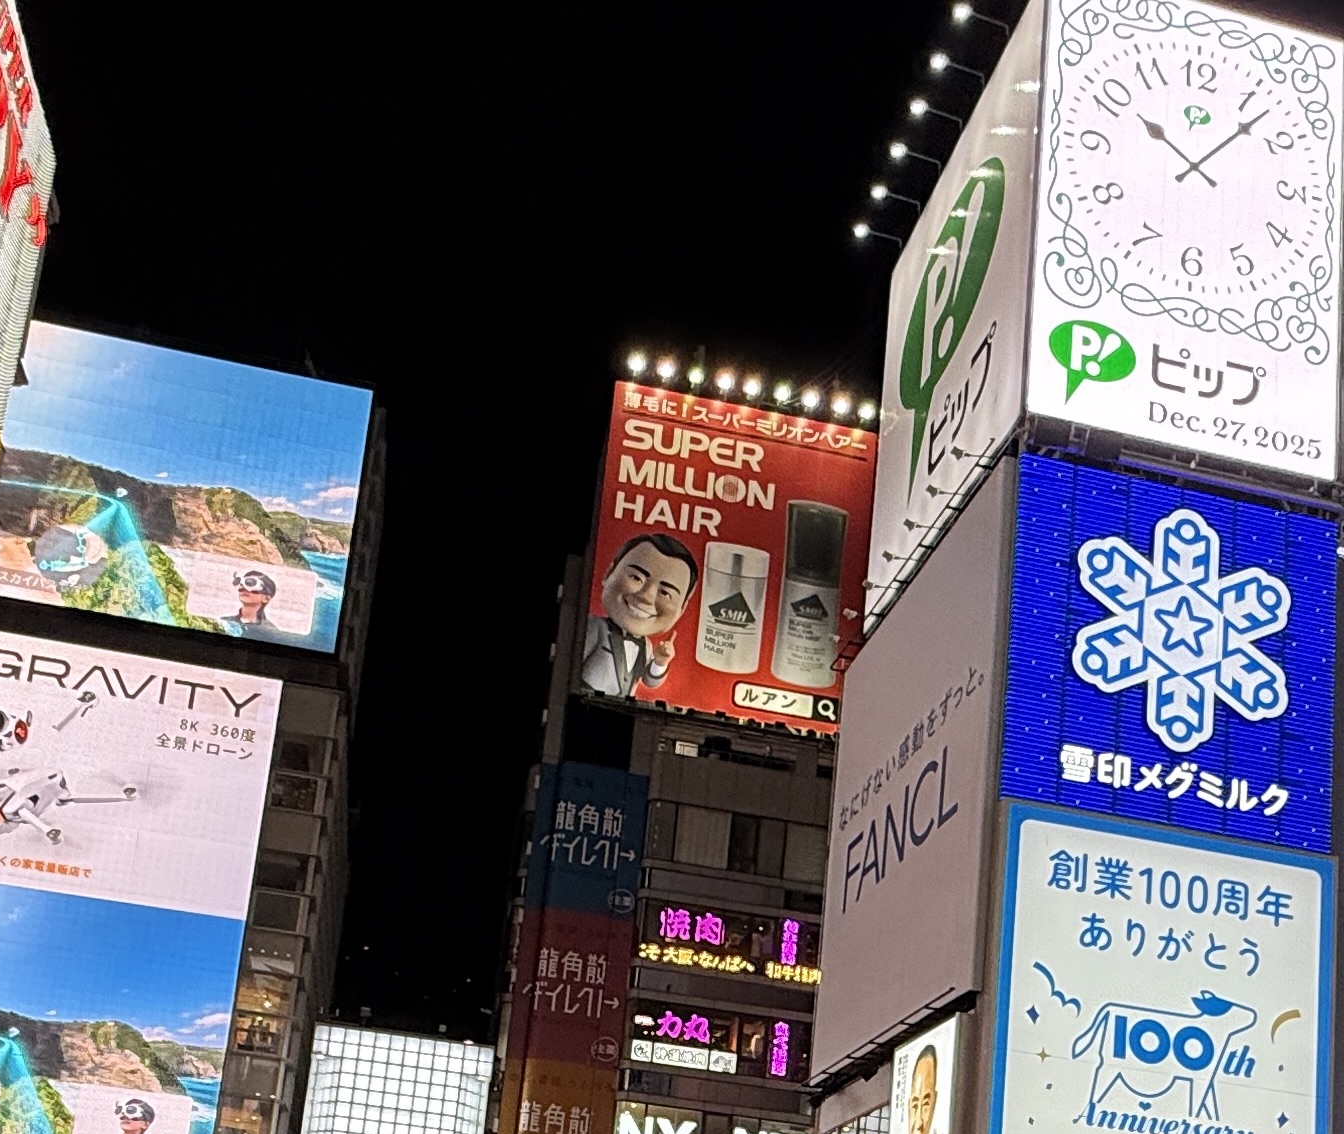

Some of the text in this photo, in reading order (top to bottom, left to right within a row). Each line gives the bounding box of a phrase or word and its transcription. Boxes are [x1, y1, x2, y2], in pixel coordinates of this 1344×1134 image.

[1134, 58, 1170, 92] 11
[1181, 59, 1217, 93] 12
[1092, 78, 1132, 118] 10
[1239, 91, 1257, 112] 1
[1080, 129, 1111, 155] 9
[1263, 131, 1295, 156] 2
[1092, 182, 1124, 205] 8
[1276, 180, 1307, 204] 3
[1132, 222, 1164, 247] 7
[1266, 221, 1293, 249] 4
[1181, 247, 1204, 277] 6
[1230, 244, 1255, 277] 5
[1151, 342, 1268, 406] ピップ
[927, 319, 998, 477] ピップ
[623, 419, 765, 473] SUPER
[1148, 401, 1323, 462] Dec. 27, 2025
[618, 455, 775, 511] MILLION
[614, 491, 723, 538] HAIR
[719, 607, 748, 623] SMH
[741, 687, 799, 710] ルアン
[156, 732, 254, 762] 全景ドローン
[179, 717, 257, 745] 8K 360度
[839, 666, 985, 832] なにげない感動をずっと。
[1060, 743, 1290, 816] 雪印メグミルク
[555, 800, 624, 838] 龍角散
[841, 745, 960, 915] FANCL
[1047, 849, 1295, 928] 創業100周年
[659, 907, 727, 946] 焼肉
[1078, 912, 1261, 977] ありがとう
[537, 948, 606, 986] 龍角散
[656, 1010, 711, 1045] 力丸
